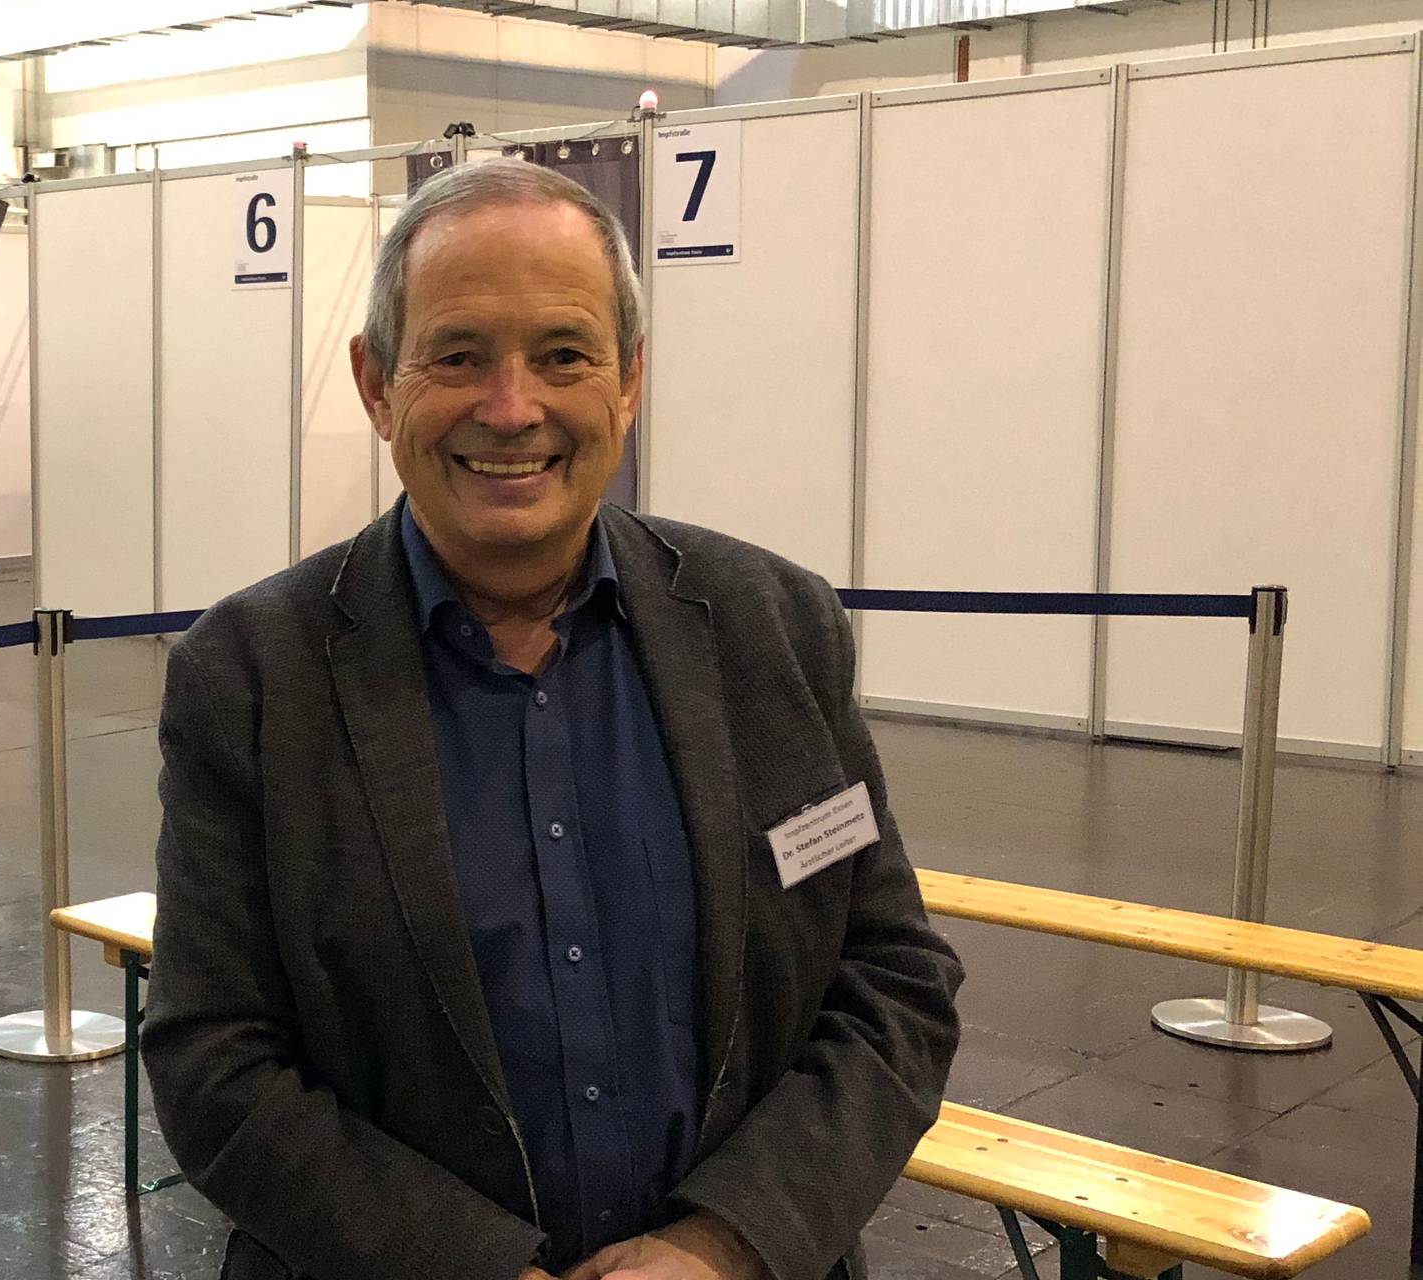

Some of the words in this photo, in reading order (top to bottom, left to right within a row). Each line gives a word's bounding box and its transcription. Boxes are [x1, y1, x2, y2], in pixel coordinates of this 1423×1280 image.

[675, 150, 716, 221] 7
[246, 192, 277, 253] 6
[782, 850, 795, 861] Dr.
[796, 834, 823, 854] Stefan
[823, 812, 865, 840] Steinmetz
